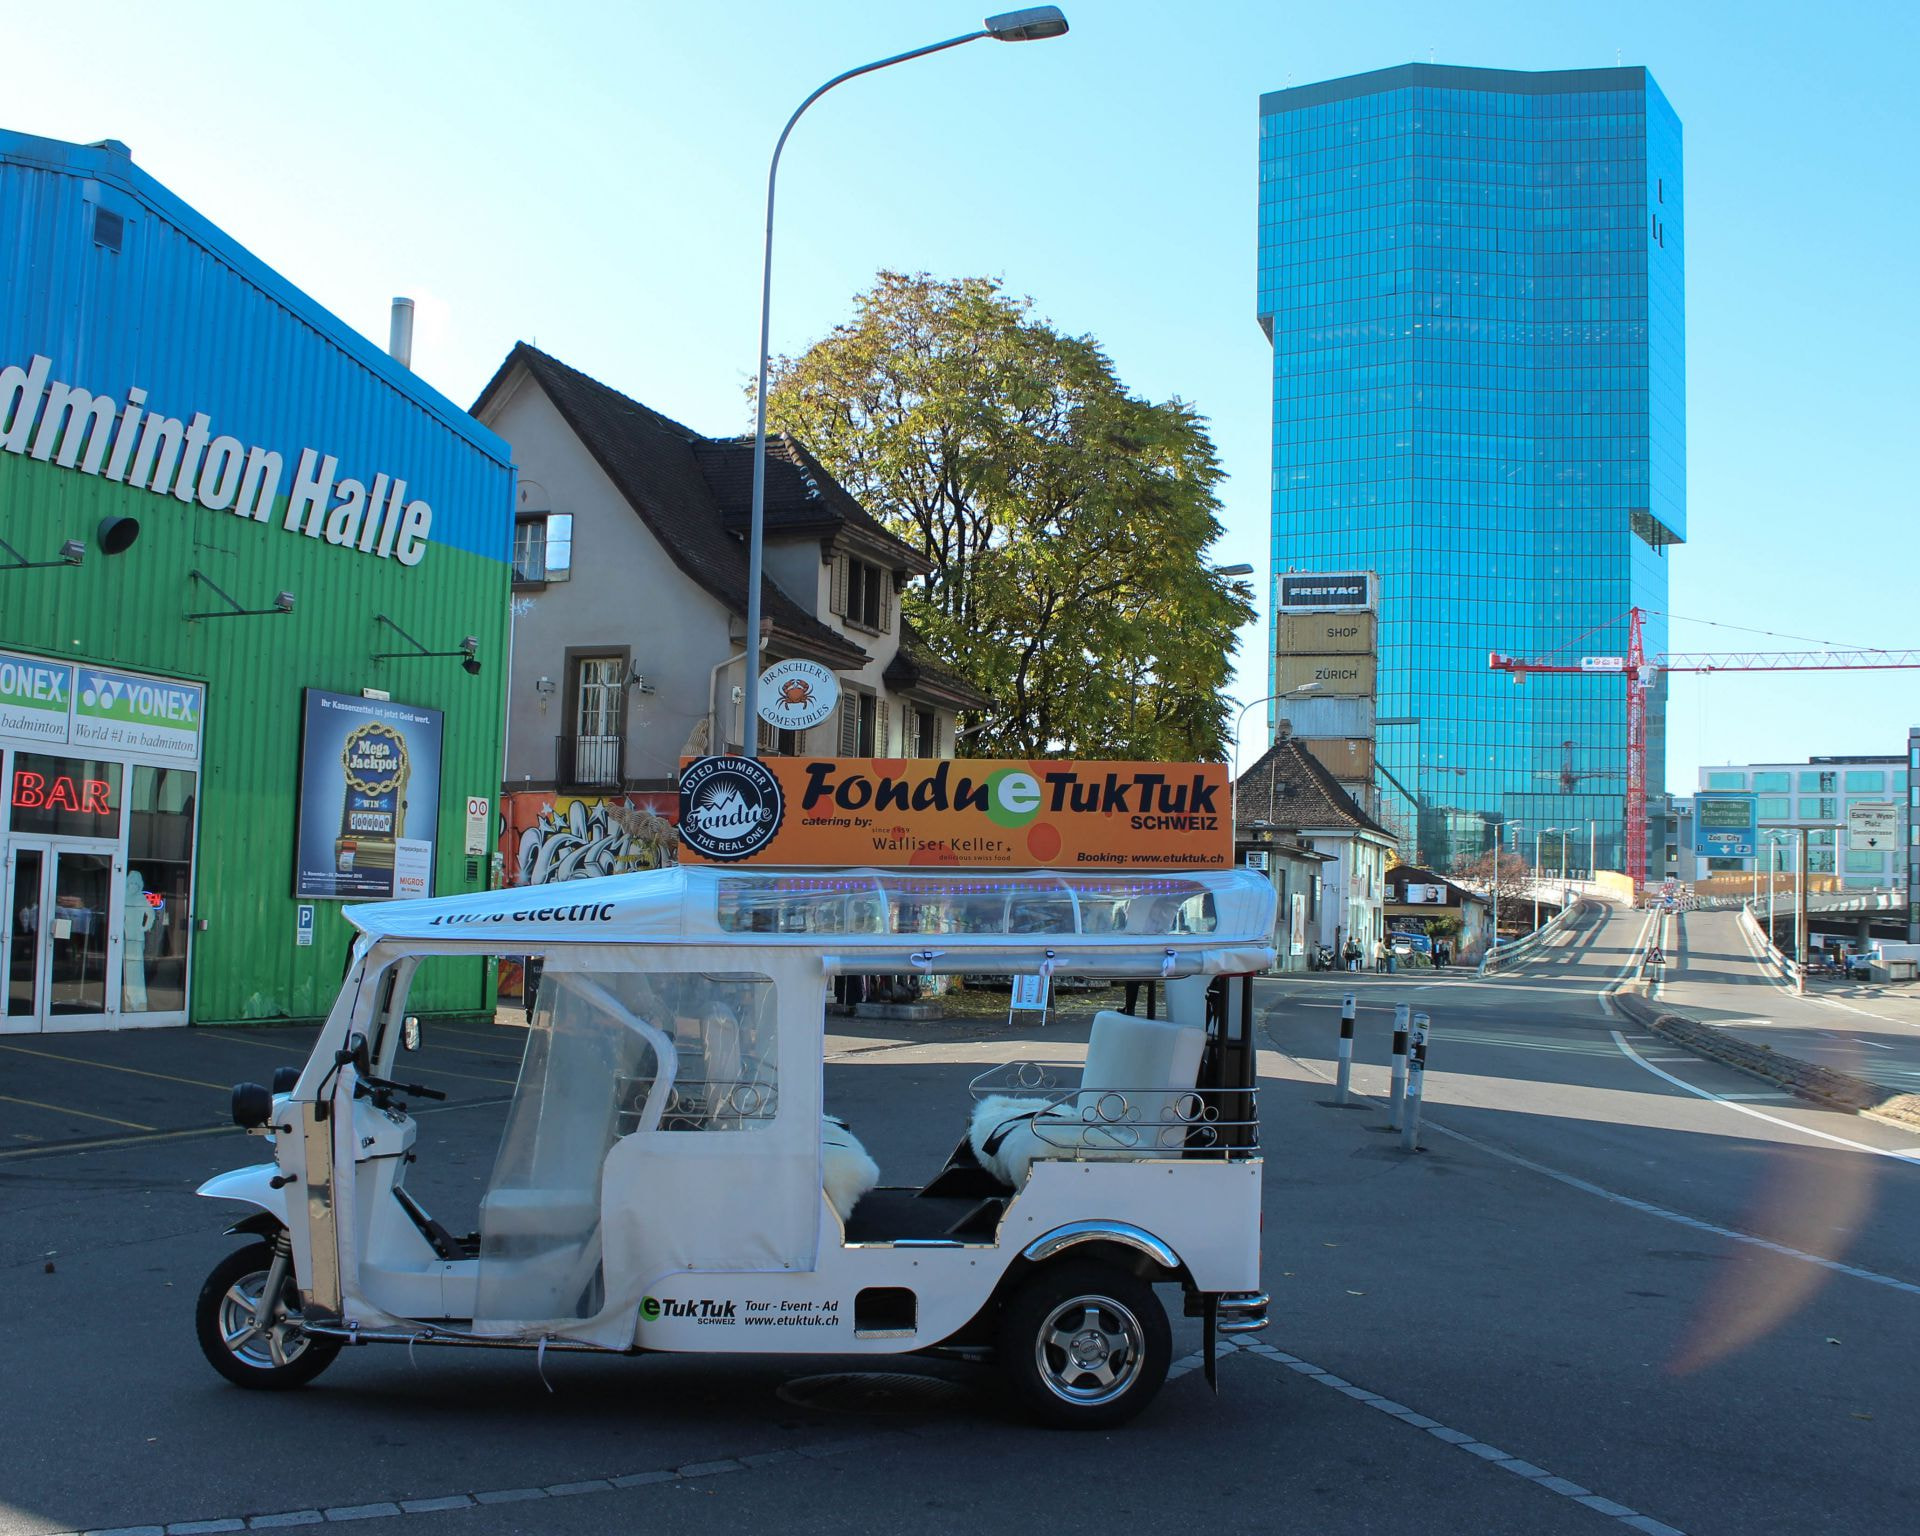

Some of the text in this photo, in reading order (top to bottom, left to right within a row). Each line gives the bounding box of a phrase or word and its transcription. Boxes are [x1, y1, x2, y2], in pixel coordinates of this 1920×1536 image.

[283, 447, 433, 566] Halle
[1289, 586, 1359, 596] FREITAG
[1327, 628, 1358, 637] SHOP
[0, 662, 65, 703] ONEX
[763, 662, 830, 686] BRASCHLER'S
[1315, 668, 1357, 680] ZÜRICH
[126, 684, 194, 722] YONEX
[321, 699, 331, 708] Ihr
[332, 700, 374, 715] Kassenzettel
[374, 706, 383, 716] ist
[383, 708, 398, 718] jetzt
[399, 711, 414, 721] Geld
[762, 703, 830, 727] COMESTIBLES
[1, 713, 65, 735] badminton.
[75, 723, 196, 753] World #1 in badminton.
[358, 740, 390, 757] Mega
[349, 754, 398, 772] Jackpot
[681, 764, 713, 795] VOTED
[717, 760, 766, 787] NUMBER
[12, 771, 111, 815] BAR
[363, 800, 380, 808] WIN
[685, 804, 773, 834] Fondue
[801, 817, 872, 828] catering by:
[1131, 815, 1218, 831] SCHWEIZ
[696, 826, 766, 851] THE REAL ONE
[872, 837, 1003, 851] Walliser Keller
[1726, 834, 1740, 842] City
[1077, 852, 1224, 864] Booking: www.etuktuk.ch
[400, 877, 424, 886] MIGROS
[302, 910, 310, 926] P
[745, 1300, 771, 1312] Tour
[780, 1300, 812, 1312] Event
[822, 1300, 838, 1312] Ad
[744, 1315, 839, 1326] www.etuktuk.ch
